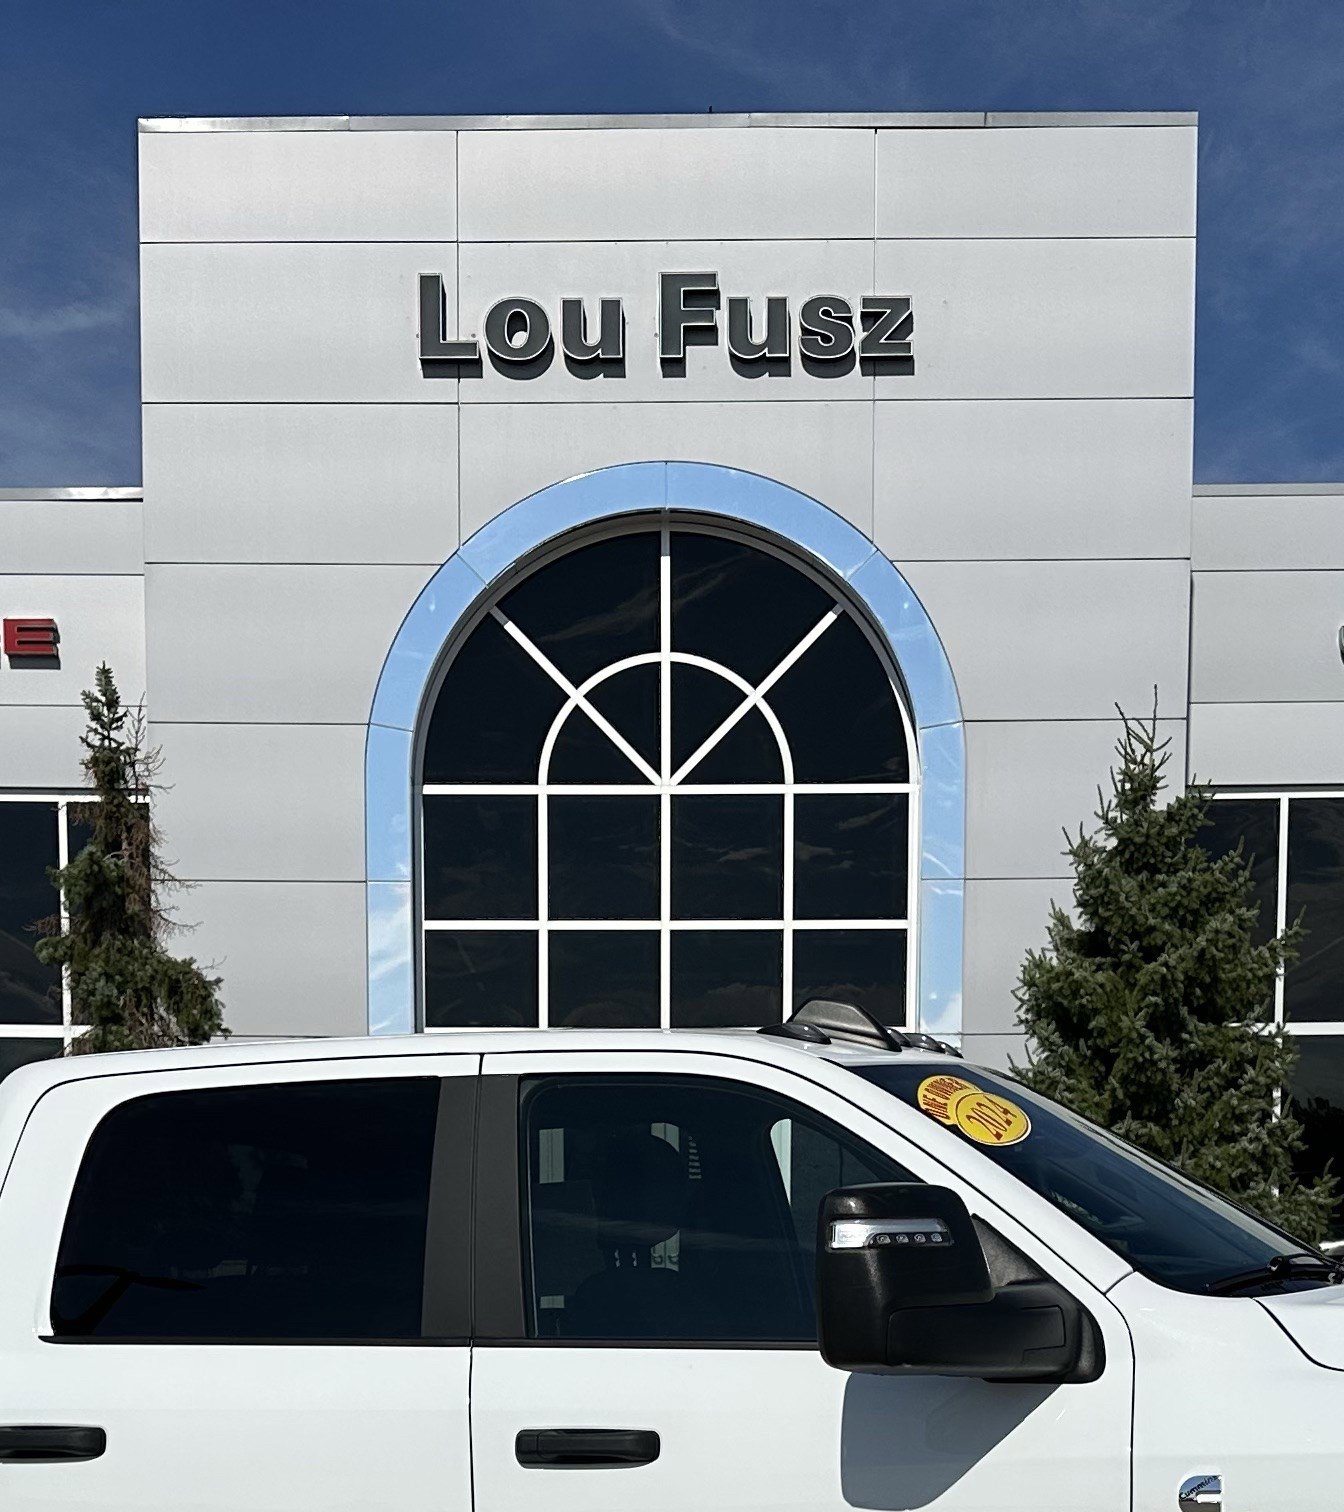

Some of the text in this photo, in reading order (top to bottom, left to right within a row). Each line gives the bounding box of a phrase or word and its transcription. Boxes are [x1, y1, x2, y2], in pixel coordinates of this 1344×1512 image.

[418, 271, 913, 360] Lou Fusz
[965, 1095, 1018, 1141] 2024
